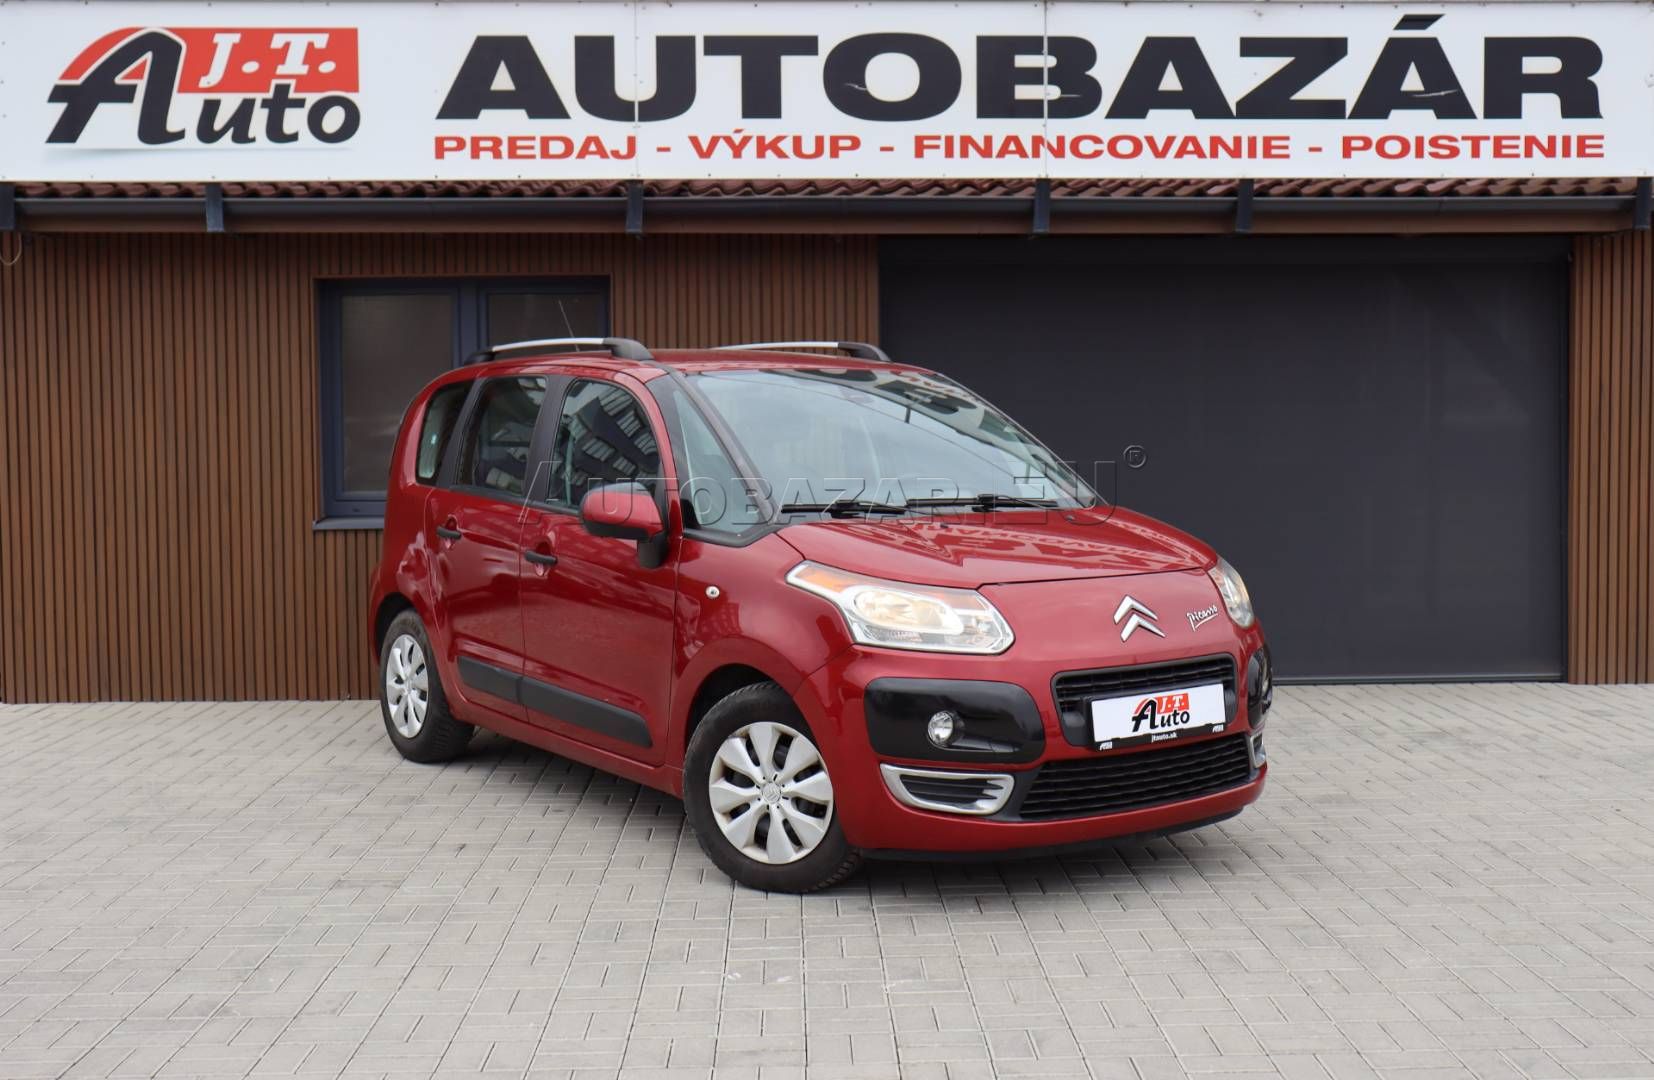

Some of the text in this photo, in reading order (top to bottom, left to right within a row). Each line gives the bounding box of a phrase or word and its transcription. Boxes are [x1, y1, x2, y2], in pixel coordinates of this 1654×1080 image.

[46, 28, 361, 145] Auto
[435, 14, 1603, 121] AUTOBAZÁR
[435, 135, 636, 160] PREDAJ
[688, 129, 861, 159] VÝKUP
[914, 134, 1290, 160] FINANCOVANIE
[1342, 134, 1605, 160] POISTENIE
[1131, 699, 1190, 733] Auto
